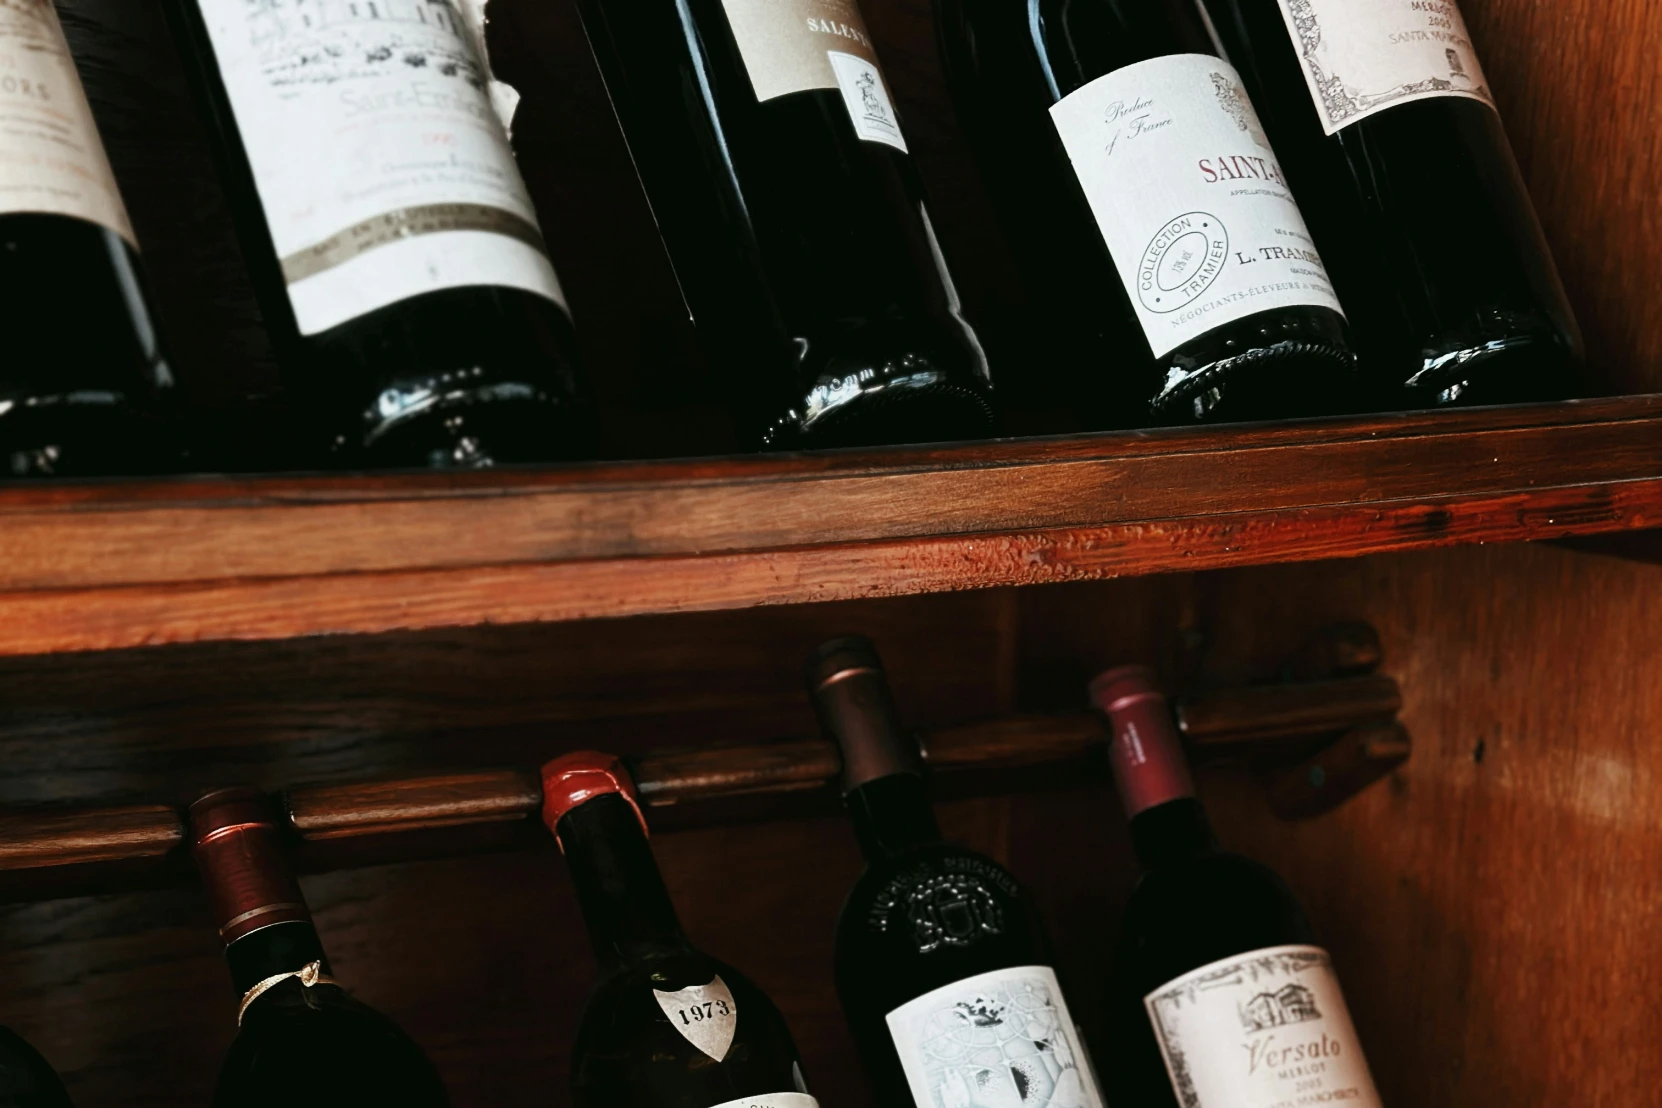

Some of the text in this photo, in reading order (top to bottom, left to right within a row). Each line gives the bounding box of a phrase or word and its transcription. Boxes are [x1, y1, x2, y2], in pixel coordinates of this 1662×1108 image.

[1105, 96, 1155, 124] Produce
[1105, 113, 1174, 156] of France
[1141, 217, 1192, 291] COLLECTION
[1179, 240, 1225, 298] TRAMIER
[1235, 251, 1257, 265] L.
[678, 999, 731, 1026] 1973
[1240, 1032, 1341, 1076] Versato
[1278, 1061, 1327, 1080] MERLOT
